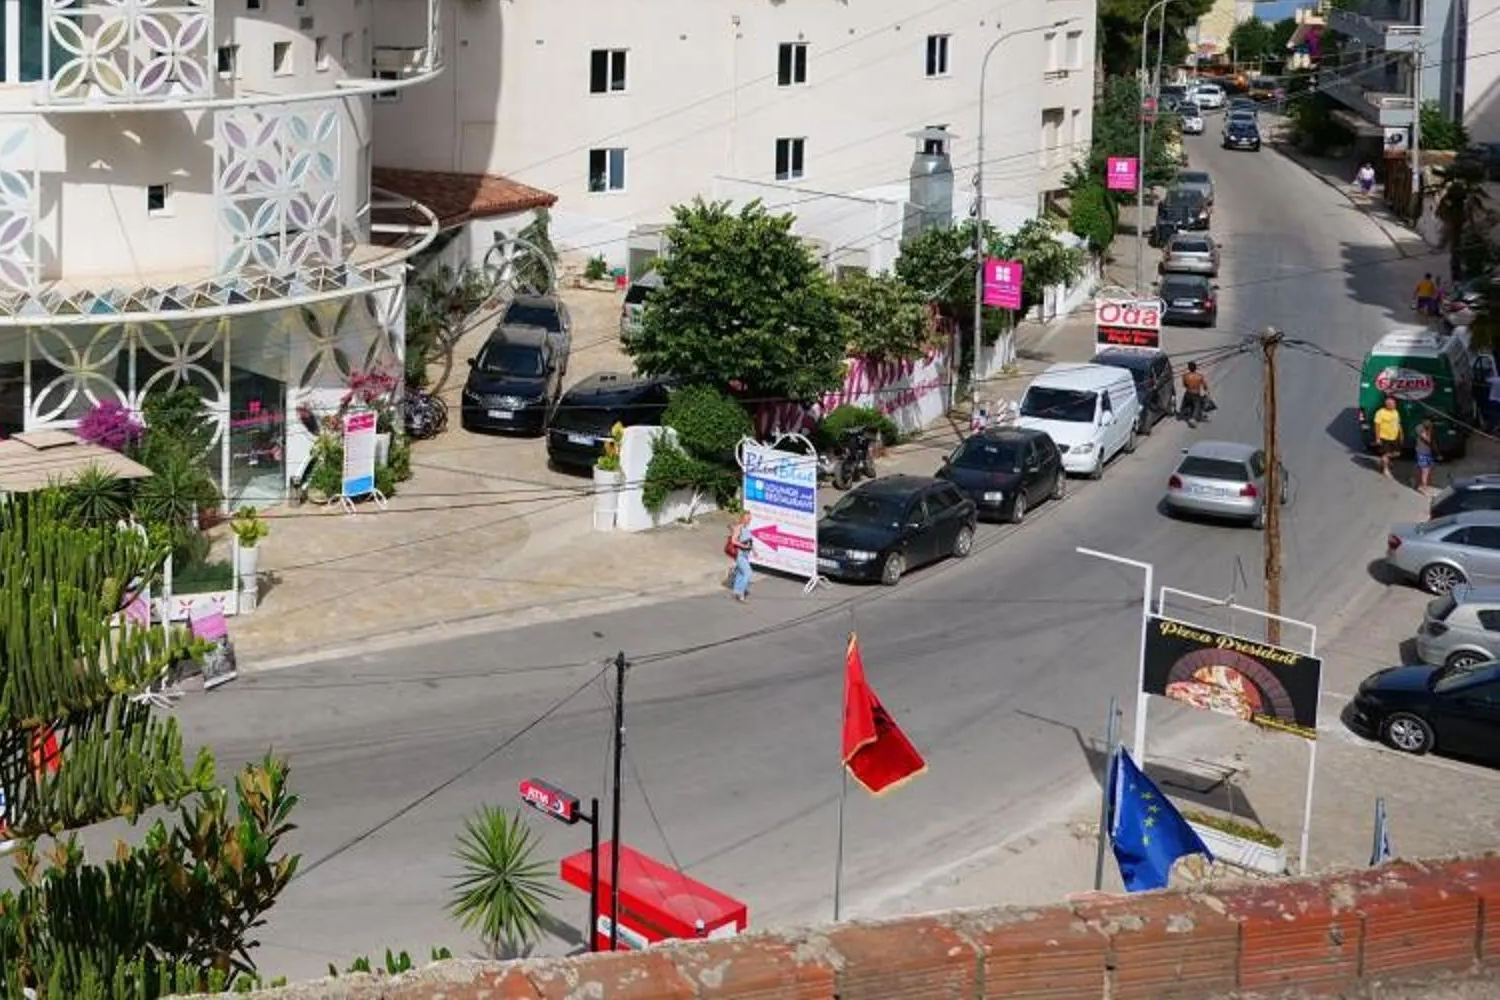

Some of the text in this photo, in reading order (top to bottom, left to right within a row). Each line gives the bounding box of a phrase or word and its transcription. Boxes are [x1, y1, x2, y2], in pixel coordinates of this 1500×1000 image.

[1099, 303, 1158, 327] Oda
[1159, 621, 1301, 666] Pizza President
[527, 786, 549, 806] ATM
